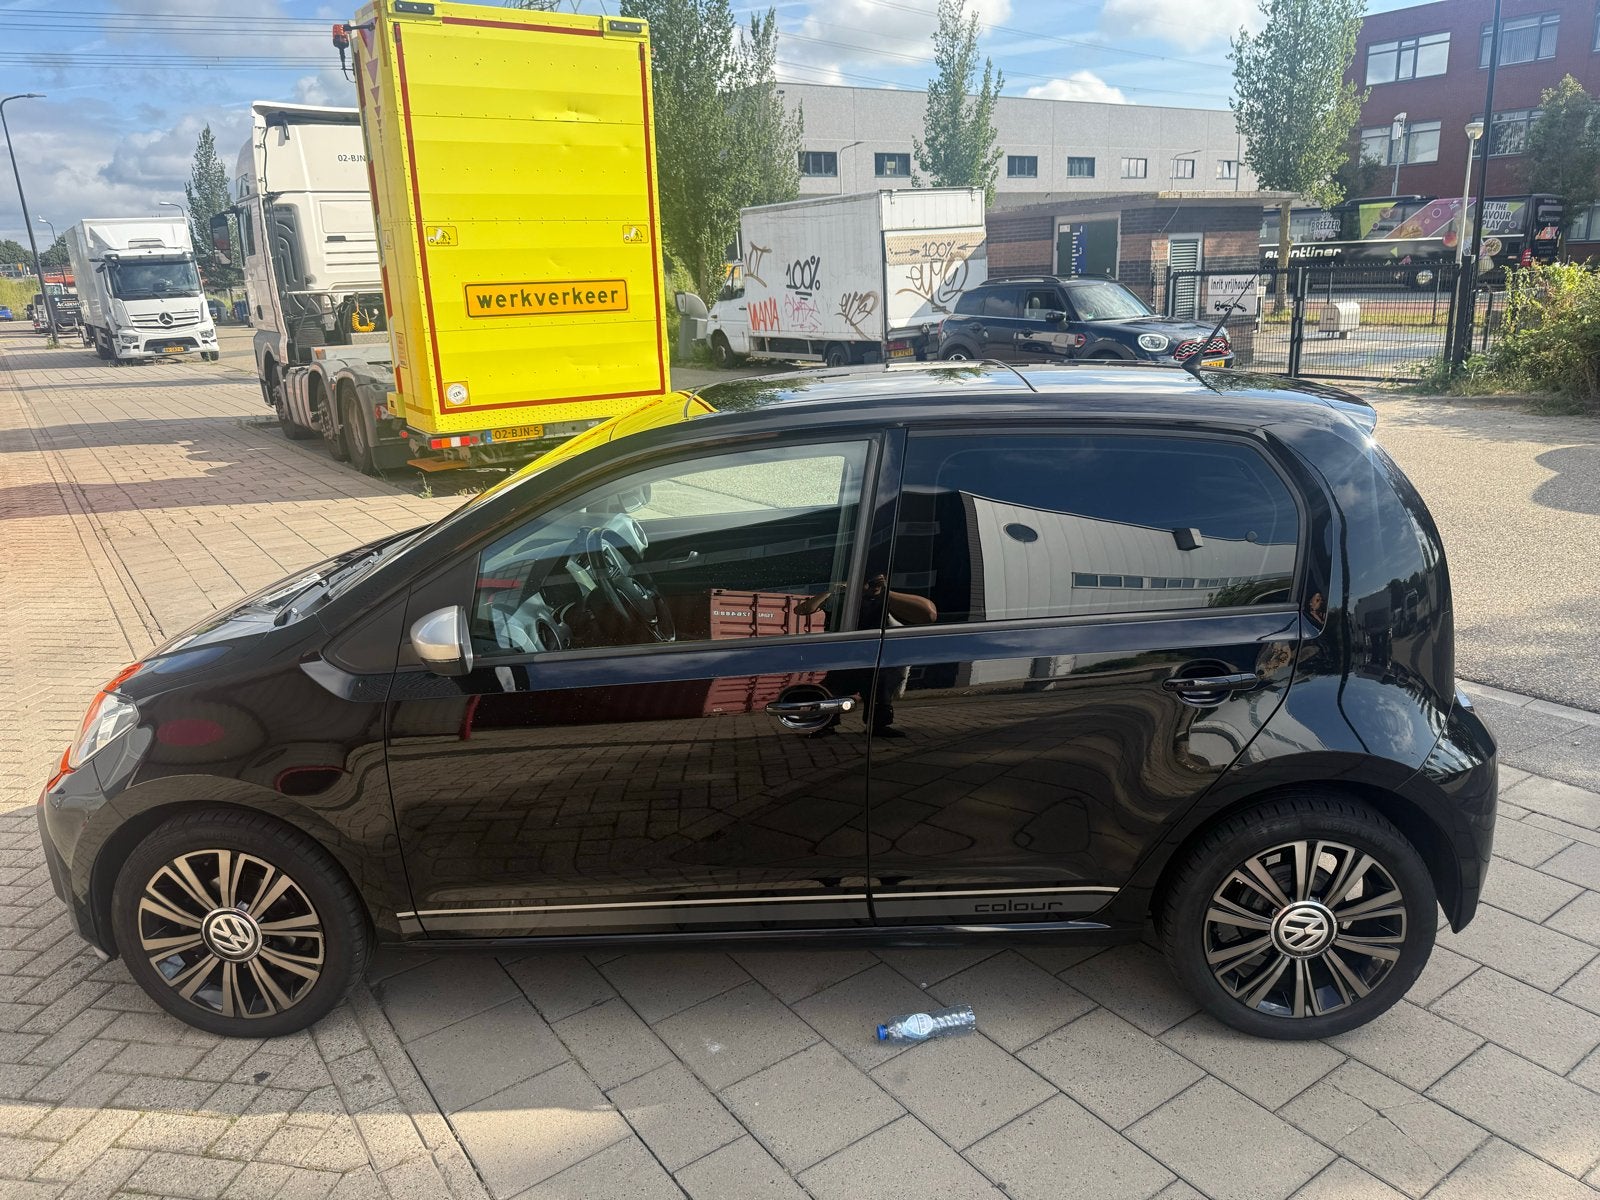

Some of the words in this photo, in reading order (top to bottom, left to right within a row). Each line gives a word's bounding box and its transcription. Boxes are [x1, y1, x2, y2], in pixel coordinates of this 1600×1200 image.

[1495, 202, 1508, 210] THE
[1482, 210, 1512, 220] AVOUR
[1311, 220, 1340, 232] BREEZER
[921, 241, 956, 258] 100%
[785, 255, 821, 290] 100%
[476, 287, 618, 309] werkverkeer
[974, 899, 1063, 912] colour
